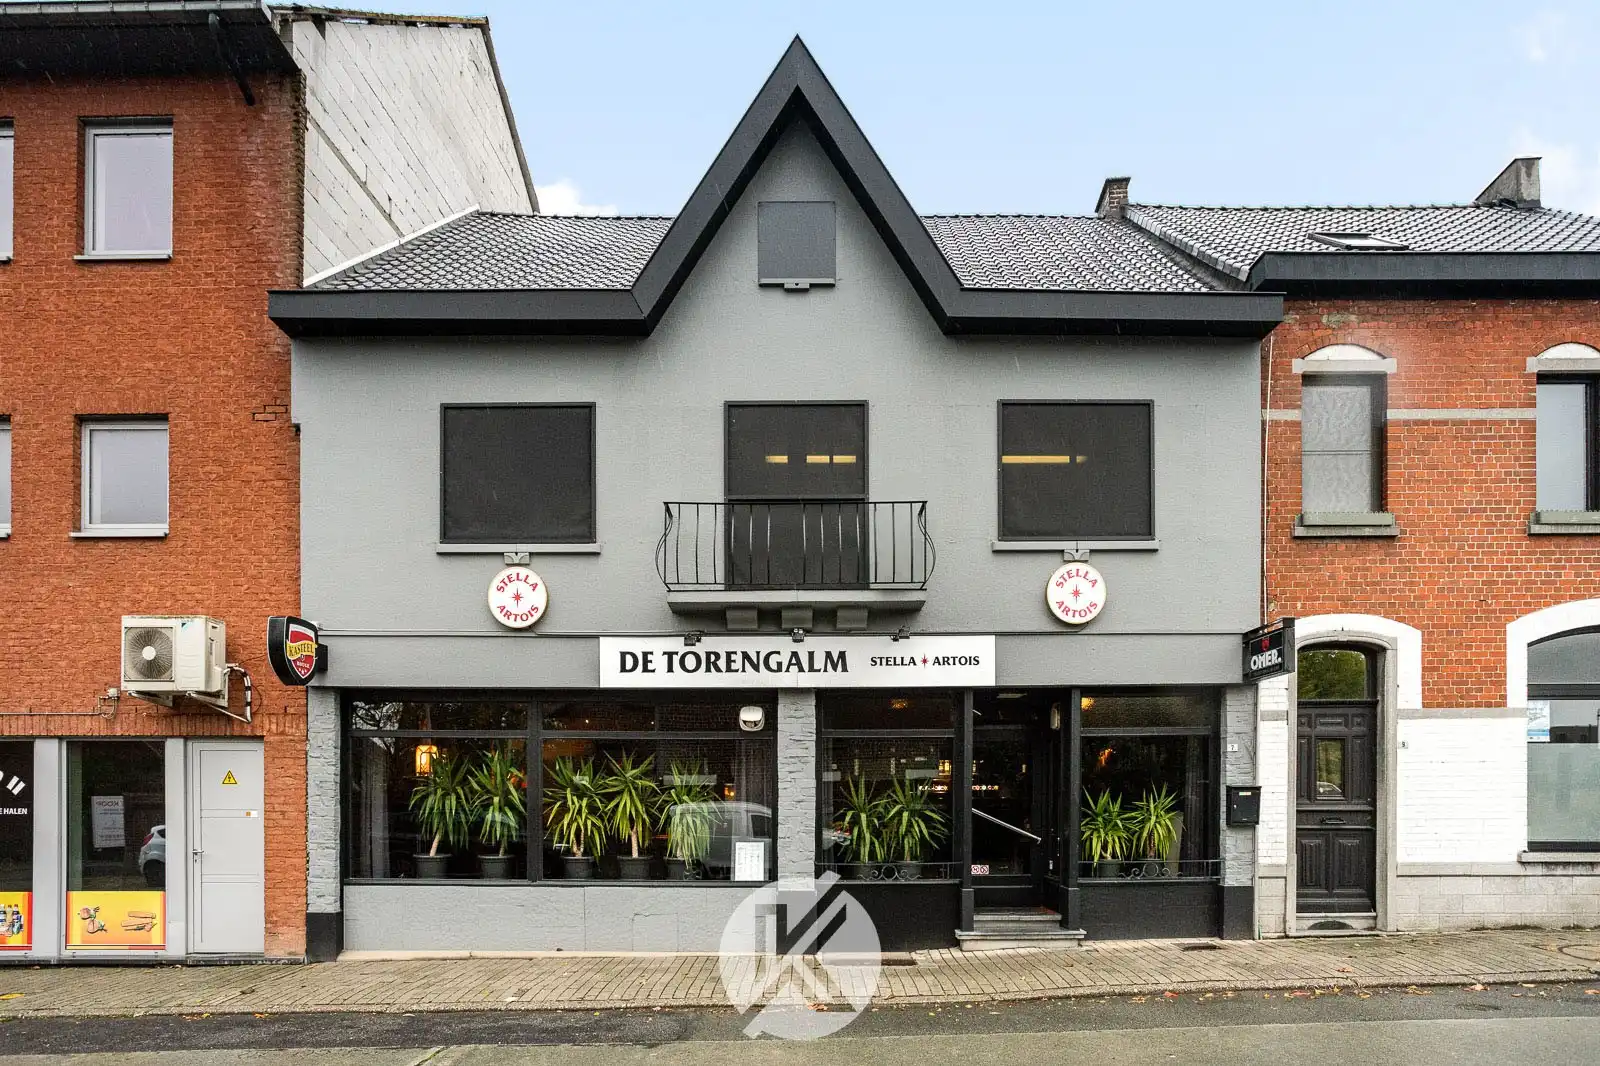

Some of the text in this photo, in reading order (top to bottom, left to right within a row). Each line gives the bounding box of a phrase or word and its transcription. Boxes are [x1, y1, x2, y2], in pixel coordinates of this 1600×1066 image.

[496, 572, 538, 592] STELLA
[1056, 568, 1098, 588] STELLA
[497, 604, 539, 622] ARTOIS
[1056, 600, 1098, 618] ARTOIS
[288, 642, 315, 657] KASTEEL
[619, 650, 849, 673] DE TORENGALM
[870, 656, 980, 666] STELLA ARTOIS
[3, 807, 28, 815] HALEN
